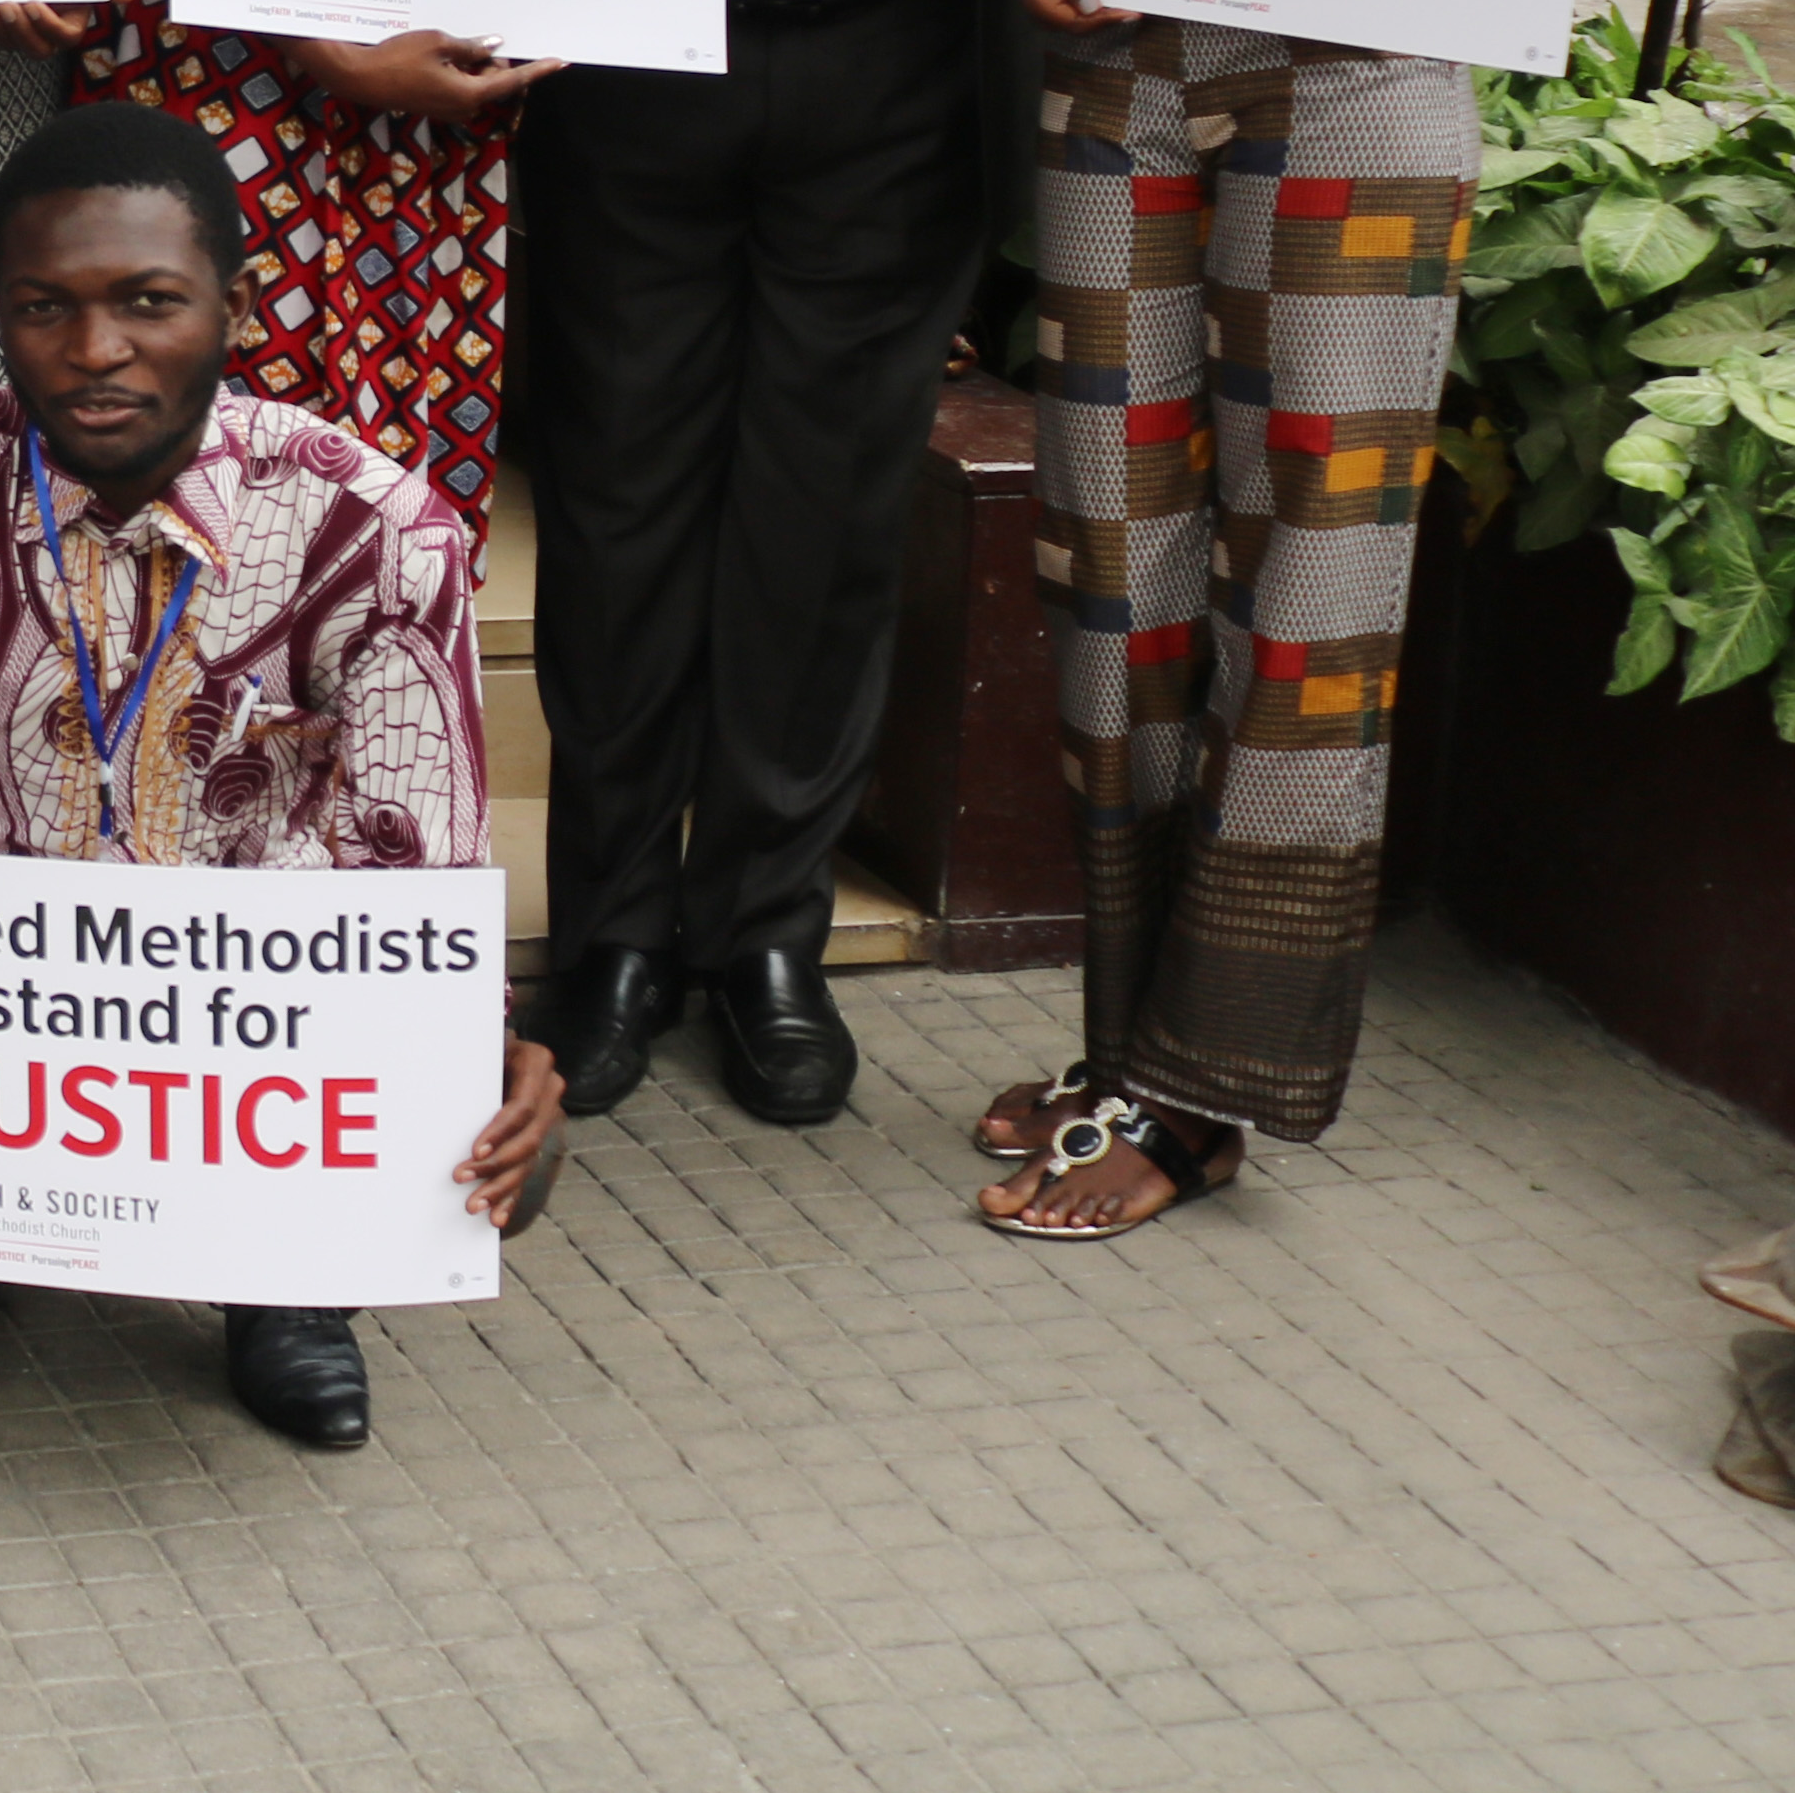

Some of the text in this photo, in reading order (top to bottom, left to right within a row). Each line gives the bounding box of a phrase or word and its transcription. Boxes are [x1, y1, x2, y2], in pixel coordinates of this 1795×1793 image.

[75, 905, 477, 973] Methodists
[207, 987, 309, 1049] for
[18, 1187, 31, 1210] &
[47, 1190, 159, 1223] SOCIETY
[49, 1223, 100, 1241] Church
